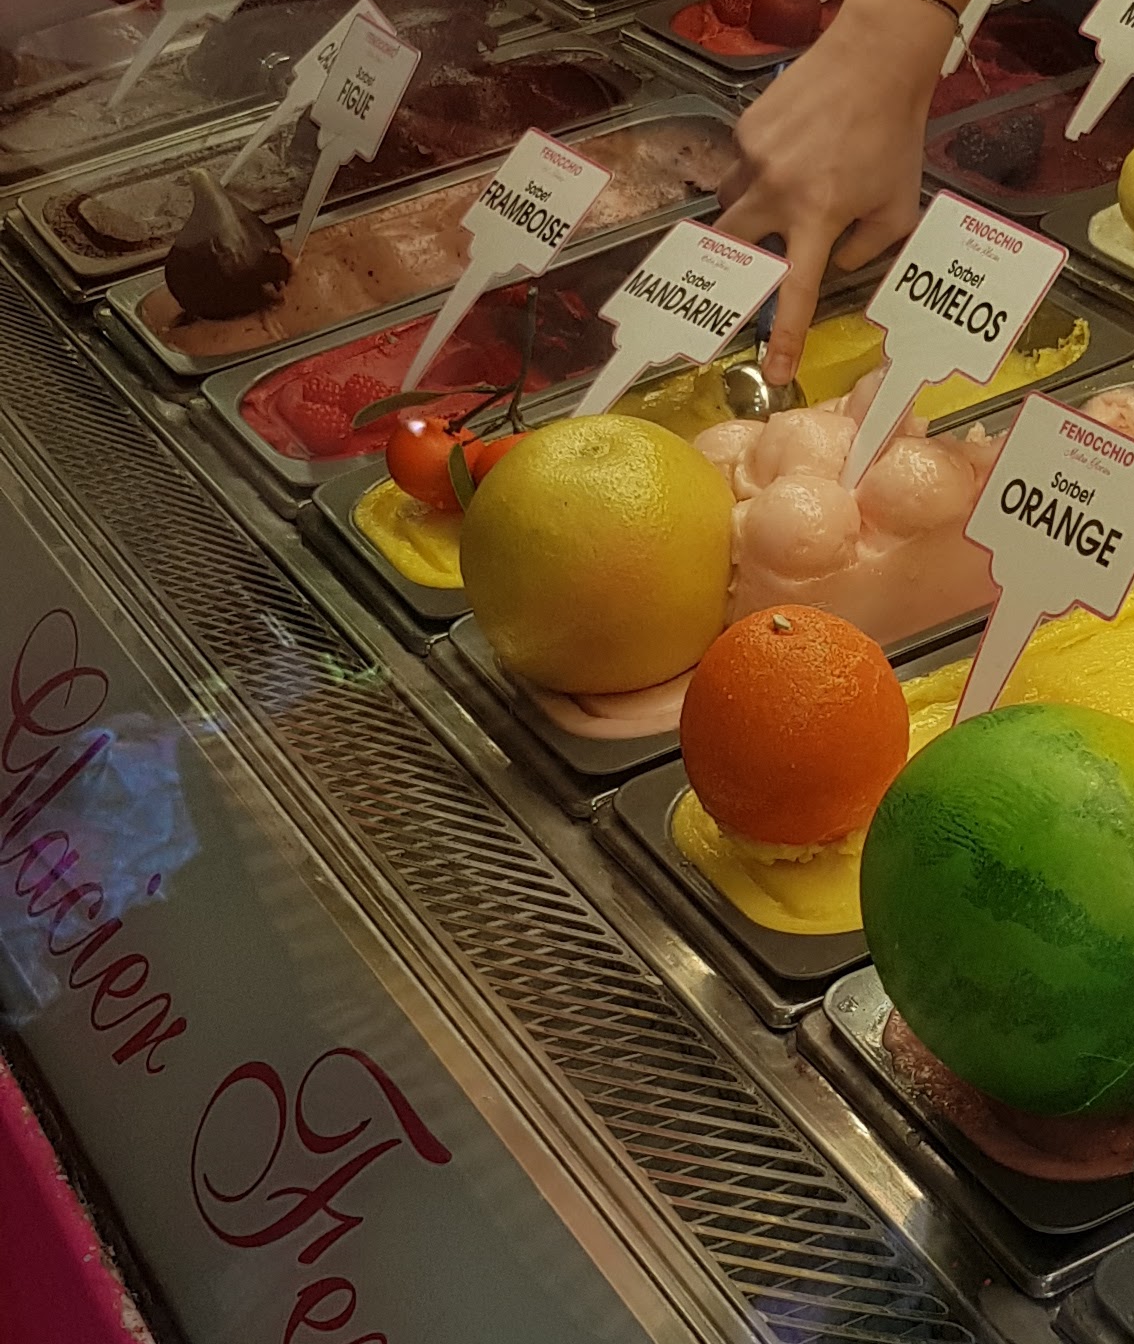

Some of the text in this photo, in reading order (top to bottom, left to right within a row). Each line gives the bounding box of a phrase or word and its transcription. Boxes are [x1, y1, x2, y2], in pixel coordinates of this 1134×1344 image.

[336, 77, 376, 121] FIGUE
[524, 180, 553, 203] Sorbet
[478, 179, 571, 249] FRAMBOISE
[959, 214, 1024, 255] FENOCCHIO
[698, 236, 754, 267] FENOCCHIO
[681, 269, 717, 292] Sorbet
[947, 259, 986, 289] Sorbet
[623, 269, 742, 337] MANDARINE
[894, 262, 1008, 343] POMELOS
[1050, 471, 1096, 506] Sorbet
[1000, 478, 1124, 569] ORANGE
